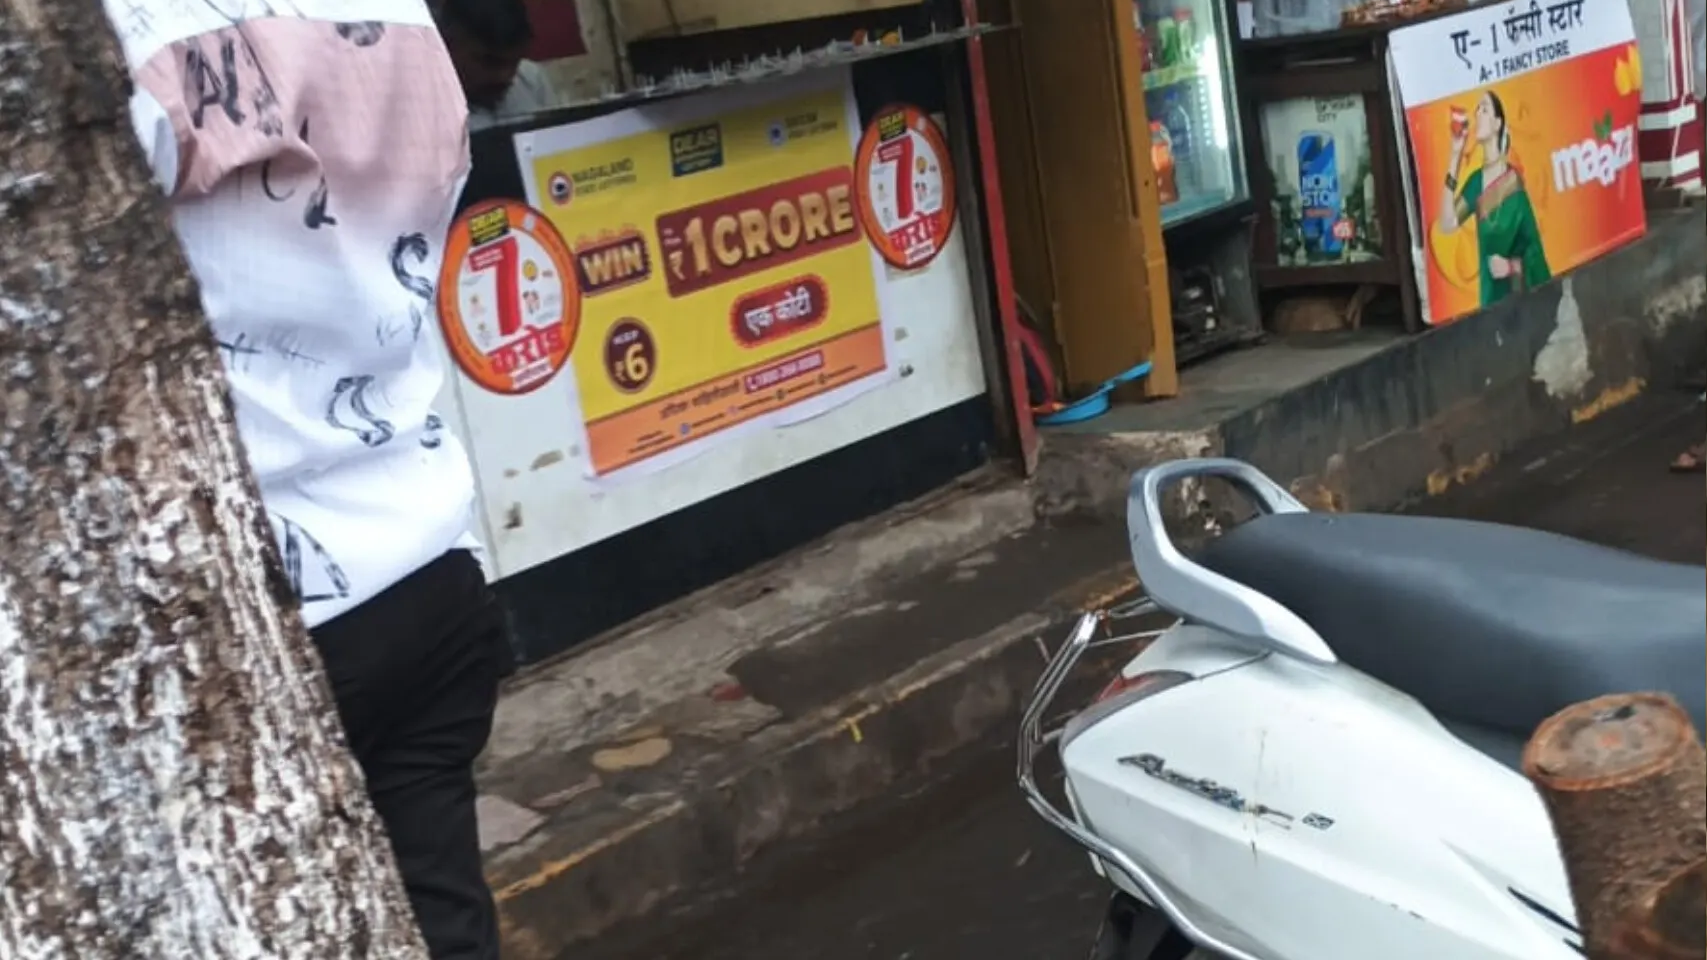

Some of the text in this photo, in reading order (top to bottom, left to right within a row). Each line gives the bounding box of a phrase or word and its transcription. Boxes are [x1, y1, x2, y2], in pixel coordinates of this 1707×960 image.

[1502, 53, 1534, 77] FANCY
[1535, 39, 1571, 66] STORE
[1551, 124, 1635, 192] maaza
[580, 242, 644, 286] WIN
[712, 184, 855, 268] CRORE
[743, 285, 812, 337] एक कोटी
